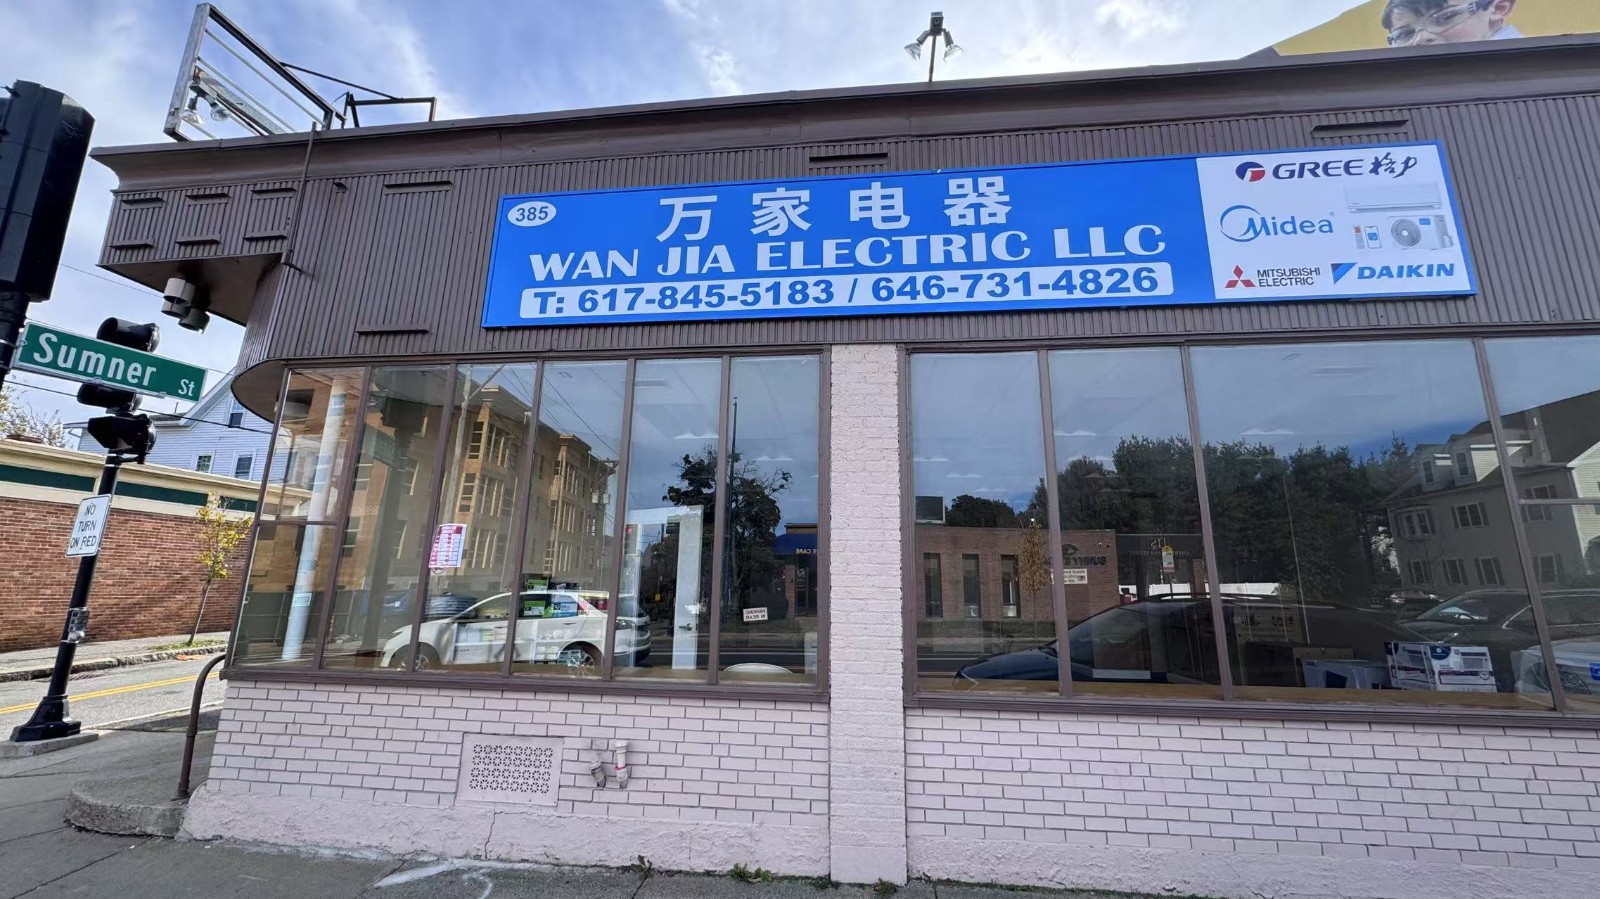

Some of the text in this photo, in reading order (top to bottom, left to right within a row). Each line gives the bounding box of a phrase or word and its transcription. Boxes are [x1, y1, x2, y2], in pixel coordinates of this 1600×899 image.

[1272, 159, 1364, 180] GREE
[514, 205, 550, 223] 385
[656, 176, 1012, 242] 万家电器
[1238, 215, 1334, 239] Midea
[529, 224, 1166, 281] WAN JIA ELECTRIC LLC
[1257, 267, 1321, 278] MITSUBISHI
[1357, 263, 1455, 280] DAIKIN
[533, 291, 565, 315] T:
[578, 279, 834, 313] 617-845-5183
[871, 267, 1159, 302] 646-731-4826
[1258, 277, 1314, 287] ELECTRIC
[33, 332, 196, 397] Sumner St
[85, 503, 97, 516] NO
[78, 519, 97, 532] TURN
[70, 535, 97, 548] ON RED
